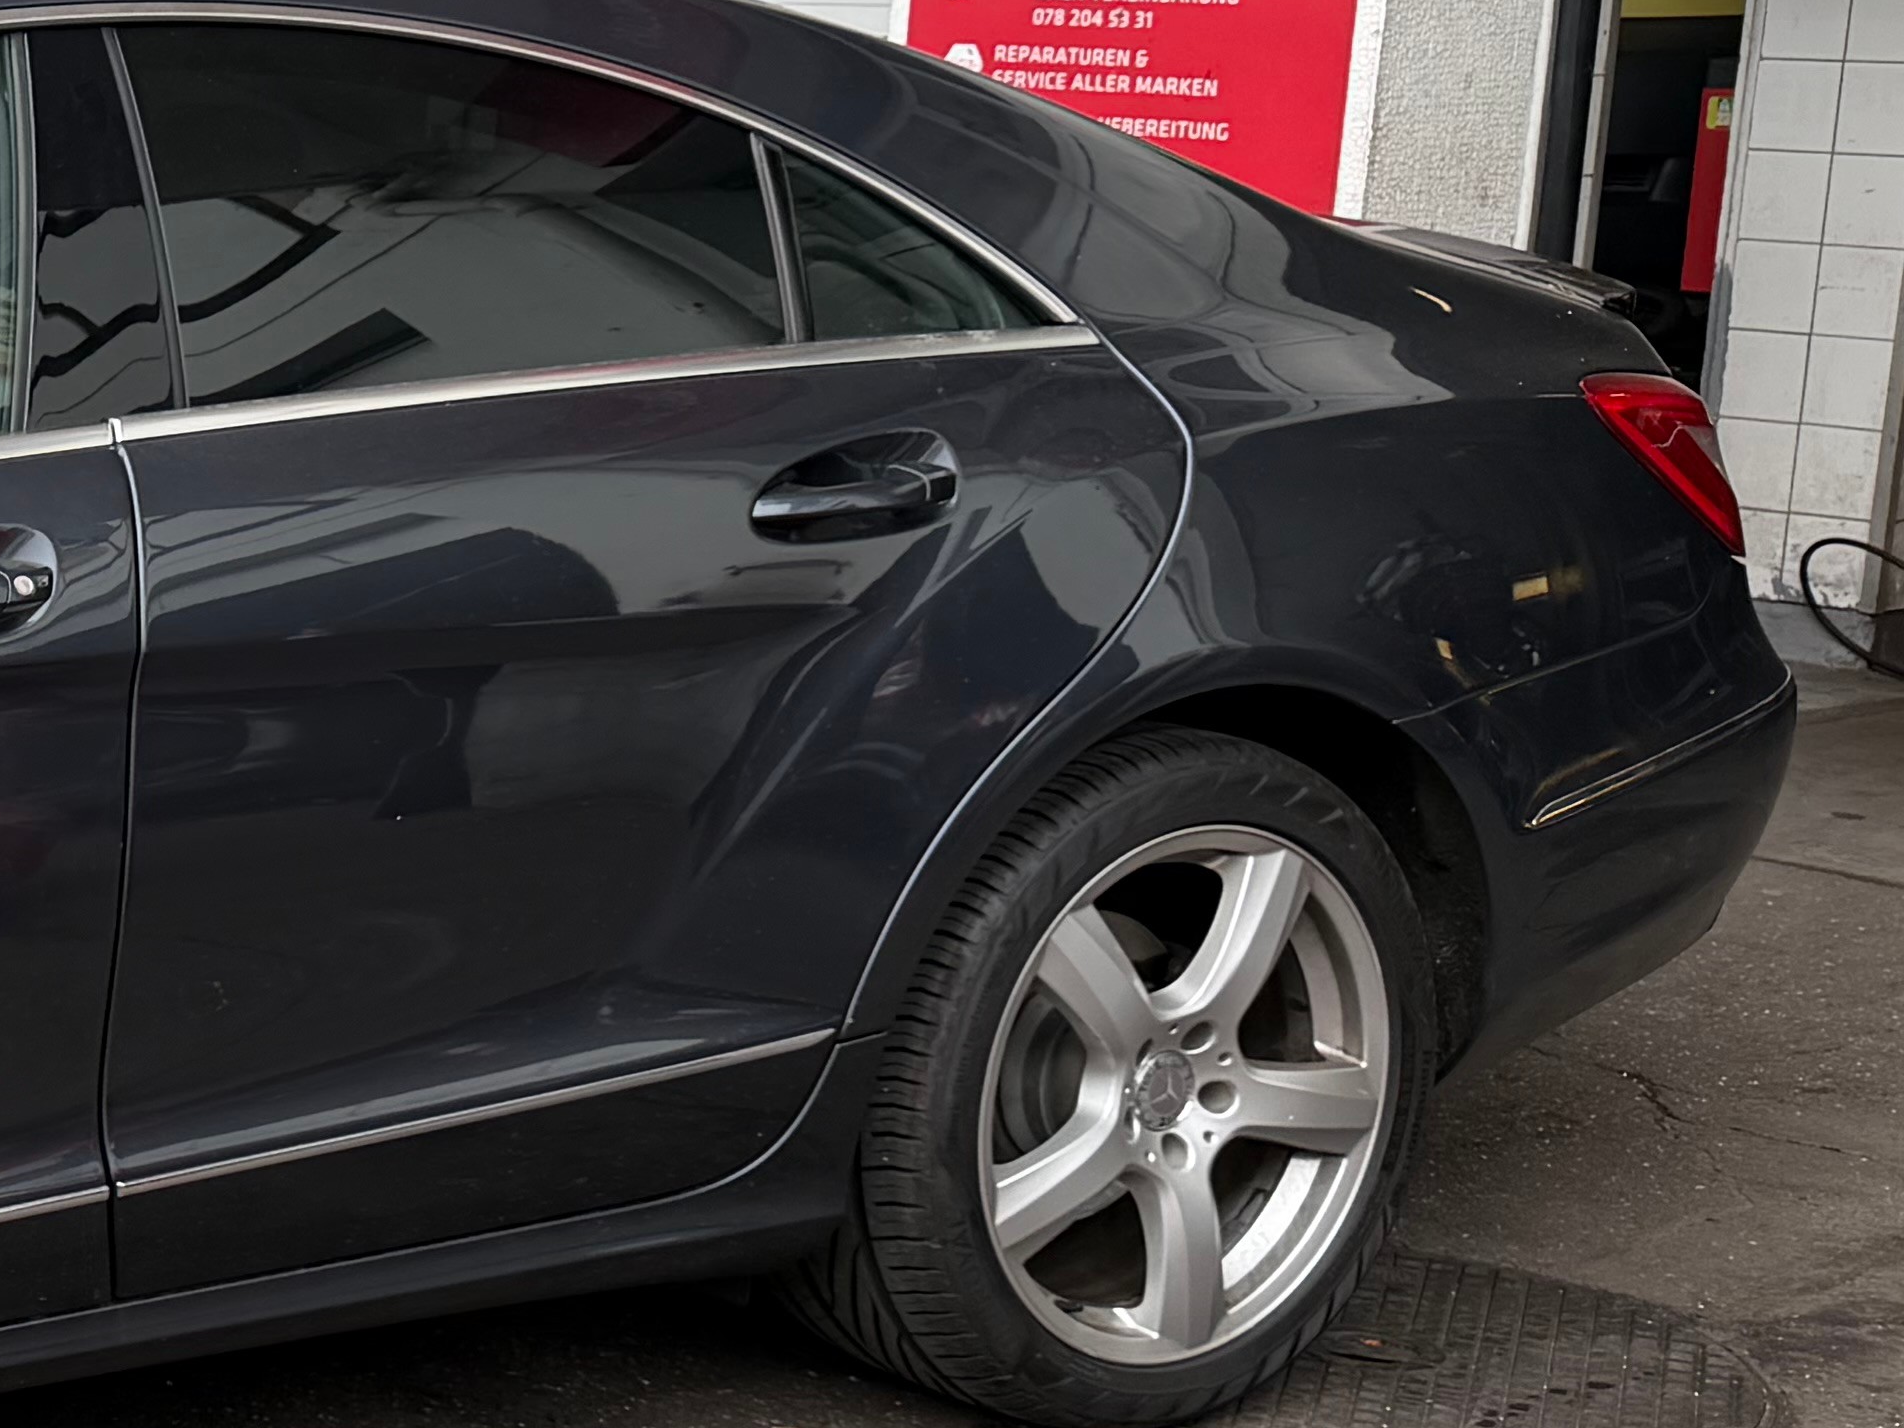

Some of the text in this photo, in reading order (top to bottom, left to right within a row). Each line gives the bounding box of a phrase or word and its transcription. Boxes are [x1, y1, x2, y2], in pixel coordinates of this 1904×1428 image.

[1032, 8, 1064, 26] 078
[1069, 9, 1102, 27] 204
[1133, 10, 1154, 29] 31
[994, 44, 1149, 68] REPARATUREN &
[1070, 73, 1130, 94] ALLER
[1135, 76, 1218, 98] MARKEN
